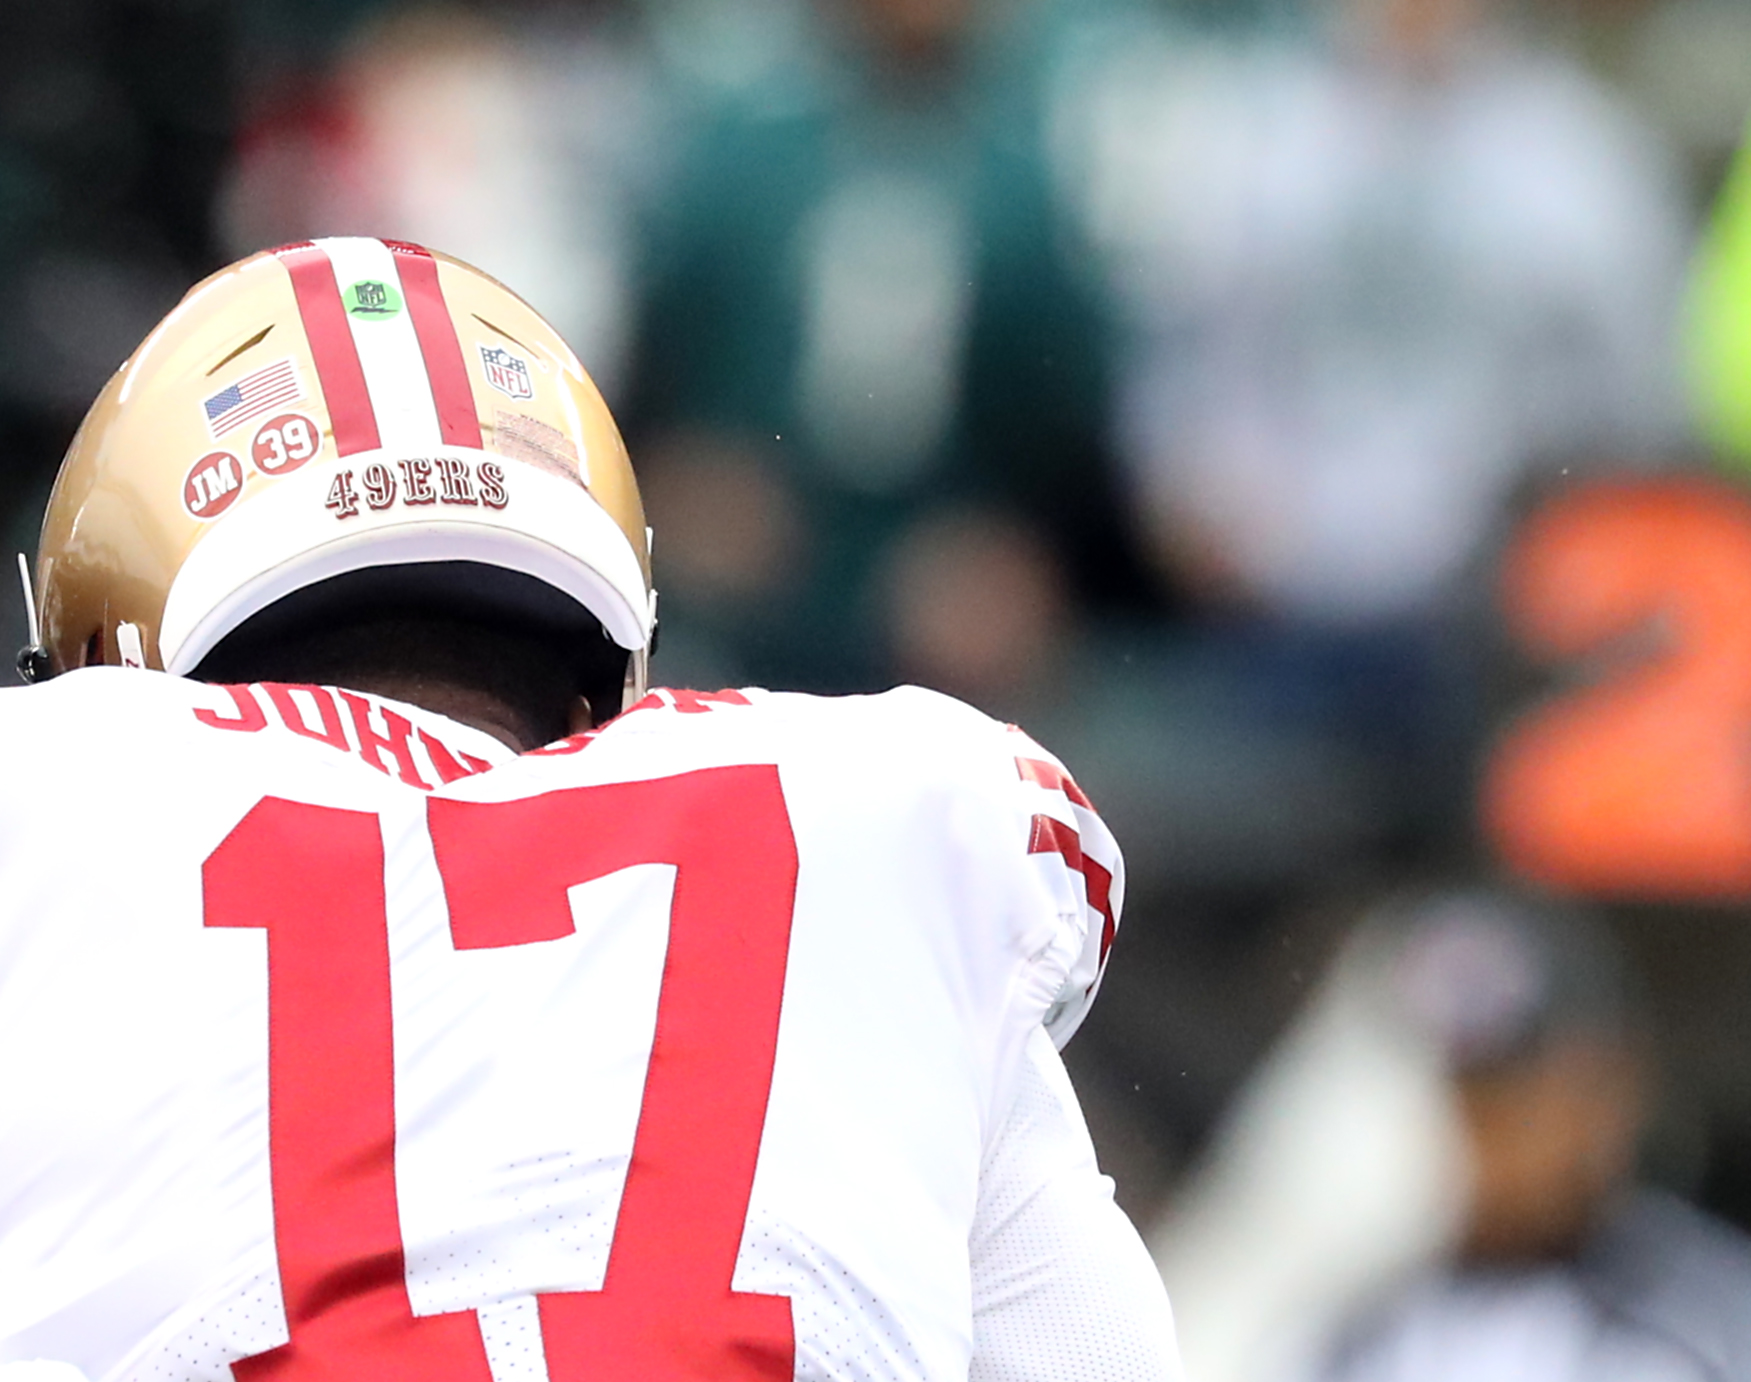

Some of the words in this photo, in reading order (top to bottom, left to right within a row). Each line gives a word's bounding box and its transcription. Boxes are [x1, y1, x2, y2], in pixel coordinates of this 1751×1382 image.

[489, 363, 529, 395] NFL
[257, 418, 314, 470] 39
[190, 456, 239, 513] JM
[324, 457, 510, 520] 49ERS
